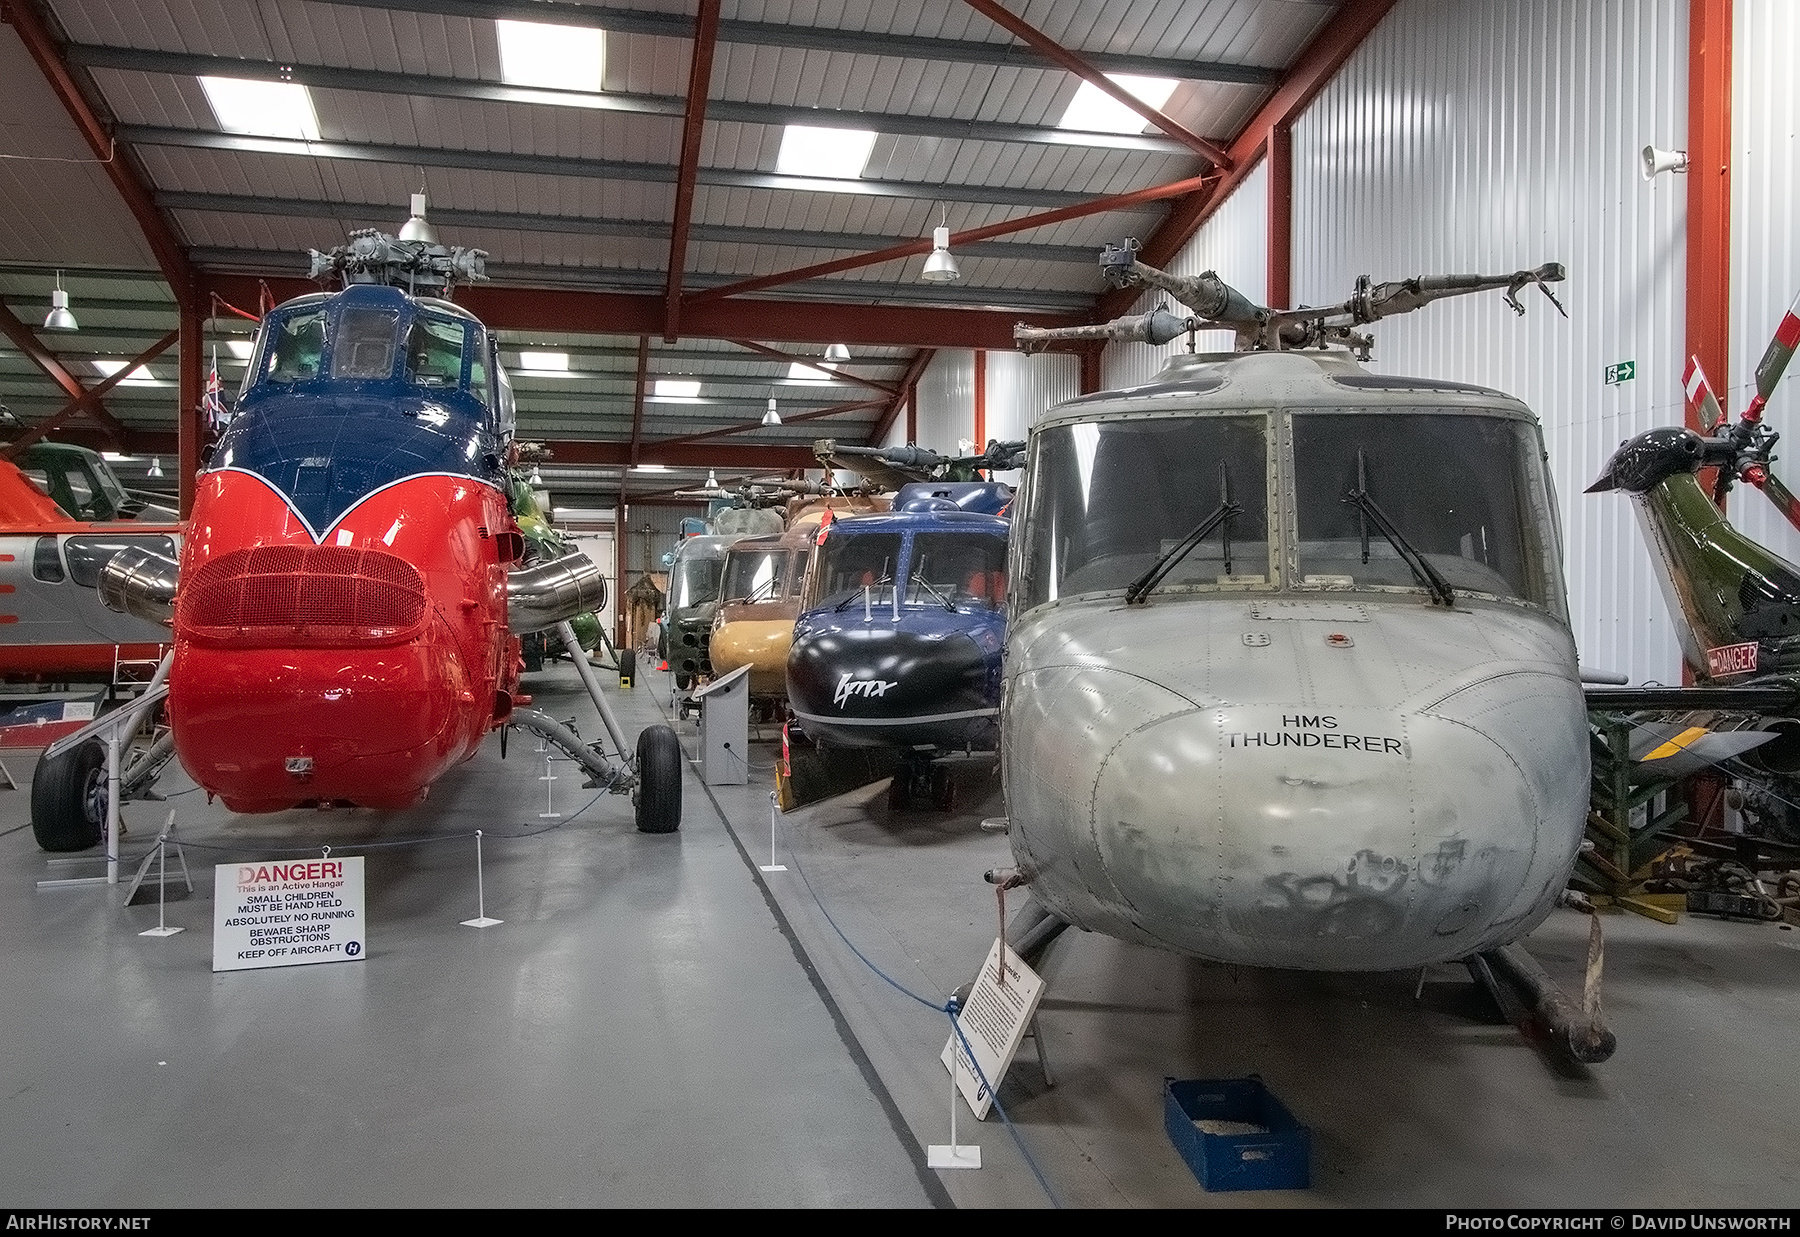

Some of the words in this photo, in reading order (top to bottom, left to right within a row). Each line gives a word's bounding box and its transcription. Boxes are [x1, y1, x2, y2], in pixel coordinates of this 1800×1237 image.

[1717, 645, 1757, 672] DANGER
[1283, 714, 1338, 729] HMS
[1224, 732, 1403, 755] THUNDERER
[238, 862, 343, 885] DANGER!
[237, 885, 257, 893] This
[258, 884, 266, 892] is
[282, 882, 310, 891] Active
[312, 880, 344, 890] Hangar
[247, 894, 282, 904] SMALL
[284, 891, 334, 902] CHILDREN
[237, 904, 267, 914] MUST
[269, 903, 283, 911] BE
[285, 901, 314, 910] HAND
[316, 899, 342, 908] HELD
[225, 914, 292, 927] ABSOLUTELY
[294, 913, 309, 922] NO
[311, 910, 355, 921] RUNNING
[250, 926, 293, 938] BEWARE
[296, 924, 331, 934] SHARP
[250, 933, 331, 946] OBSTRUCTIONS
[237, 950, 265, 960] KEEP
[268, 948, 288, 957] OFF
[290, 943, 342, 955] AIRCRAFT
